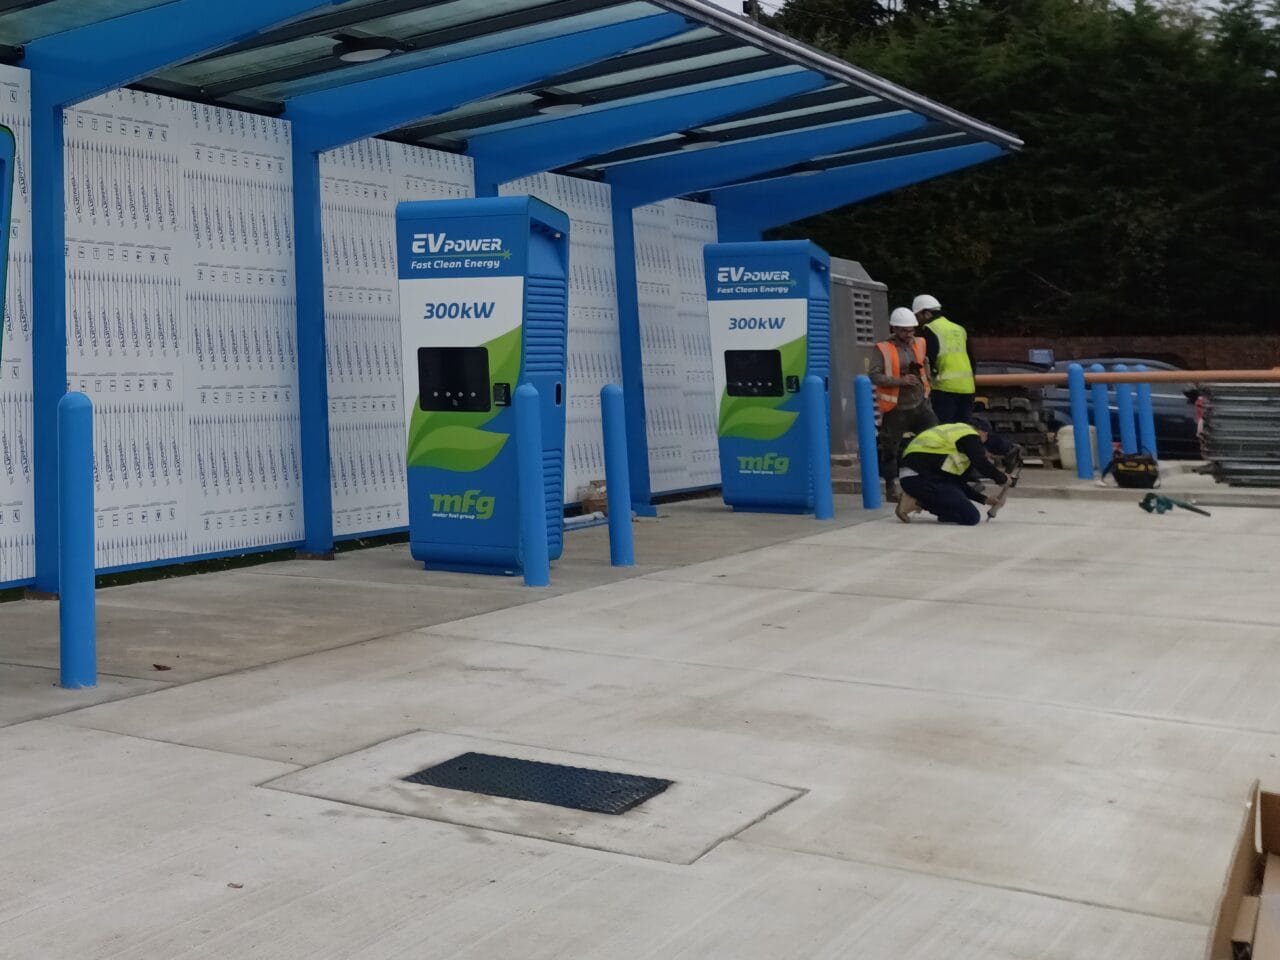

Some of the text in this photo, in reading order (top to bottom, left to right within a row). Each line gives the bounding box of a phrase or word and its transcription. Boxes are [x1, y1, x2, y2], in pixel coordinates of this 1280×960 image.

[411, 259, 500, 270] Fast Clean Energy
[735, 286, 758, 294] Clean
[760, 286, 789, 294] Energy
[424, 302, 495, 320] 300kW
[728, 317, 785, 331] 300kW
[430, 490, 495, 519] mfg
